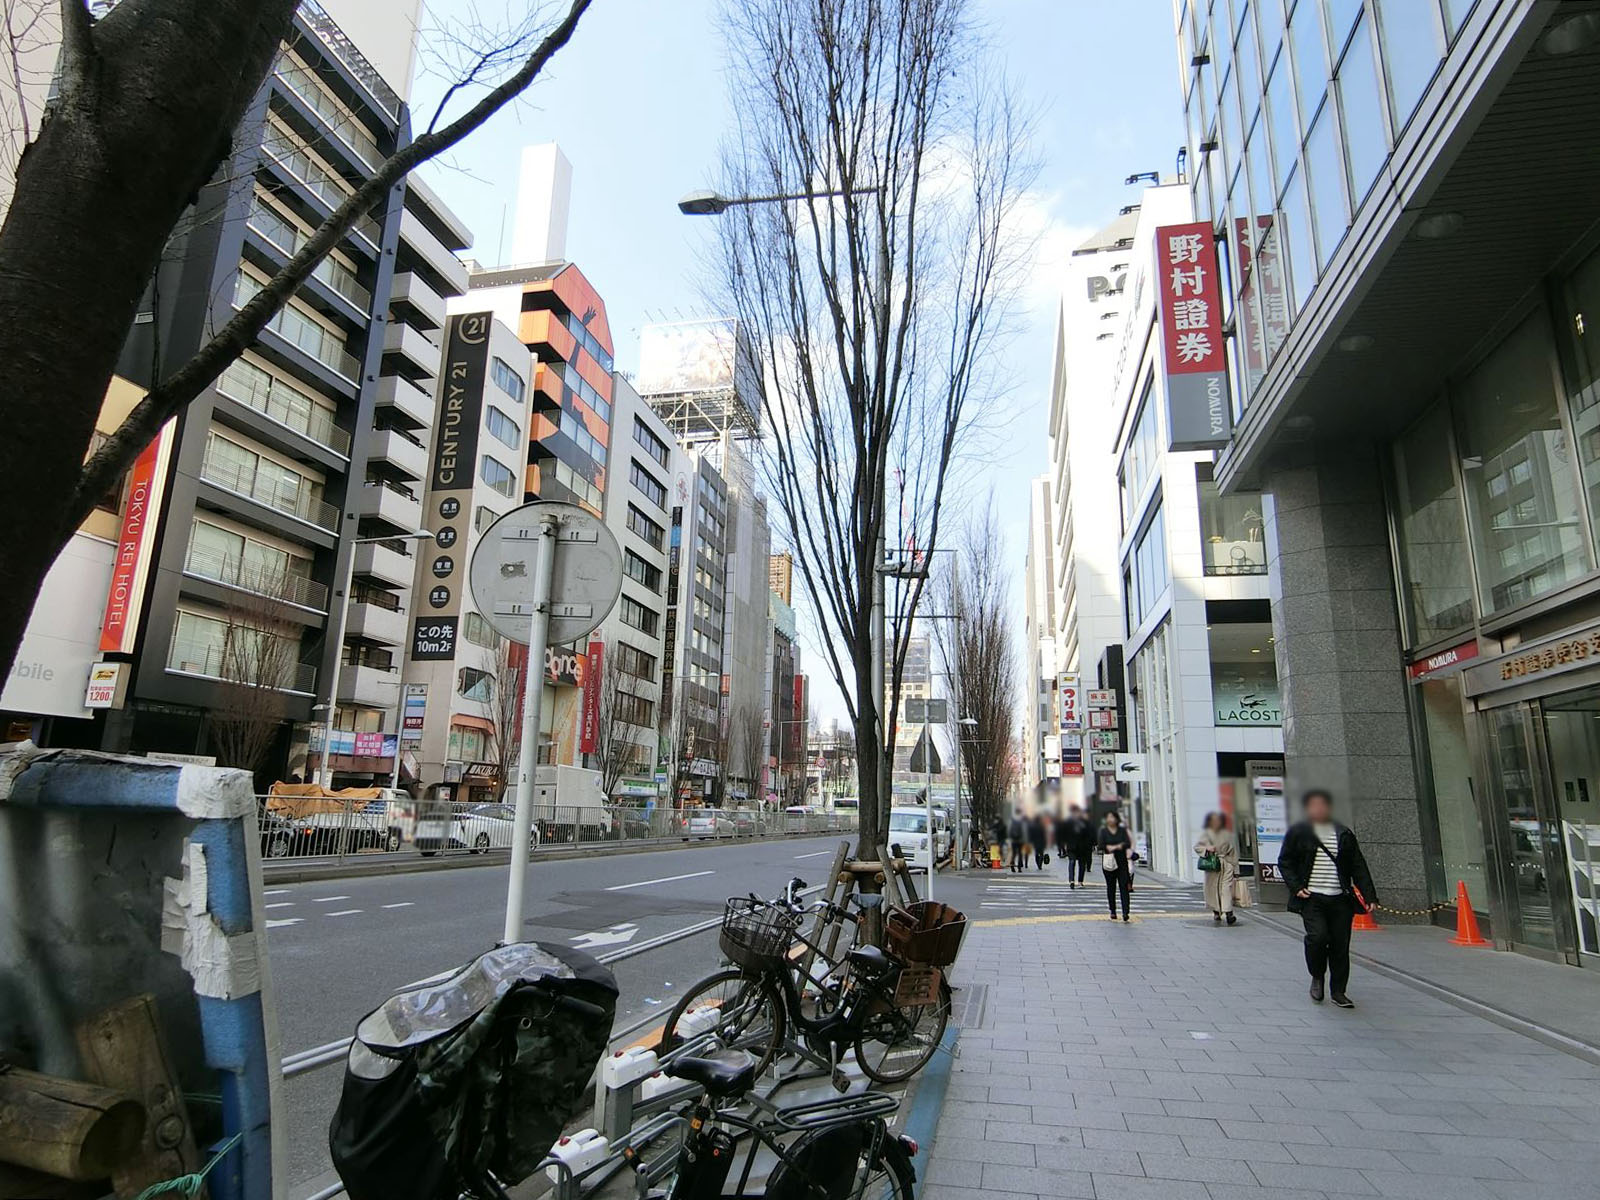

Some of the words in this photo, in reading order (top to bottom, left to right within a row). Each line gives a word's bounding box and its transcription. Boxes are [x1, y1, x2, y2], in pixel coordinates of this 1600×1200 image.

[1168, 233, 1213, 363] 野村證券
[440, 385, 465, 484] CENTURY
[453, 361, 468, 381] 21
[1206, 377, 1224, 436] NOMURA
[128, 480, 148, 535] TOKYU
[122, 542, 135, 567] REI
[108, 574, 131, 629] HOTEL
[418, 625, 454, 639] この先
[544, 646, 584, 681] dance
[1428, 650, 1458, 669] NOMURA
[1063, 689, 1076, 721] つり具
[1219, 710, 1281, 721] LACOST
